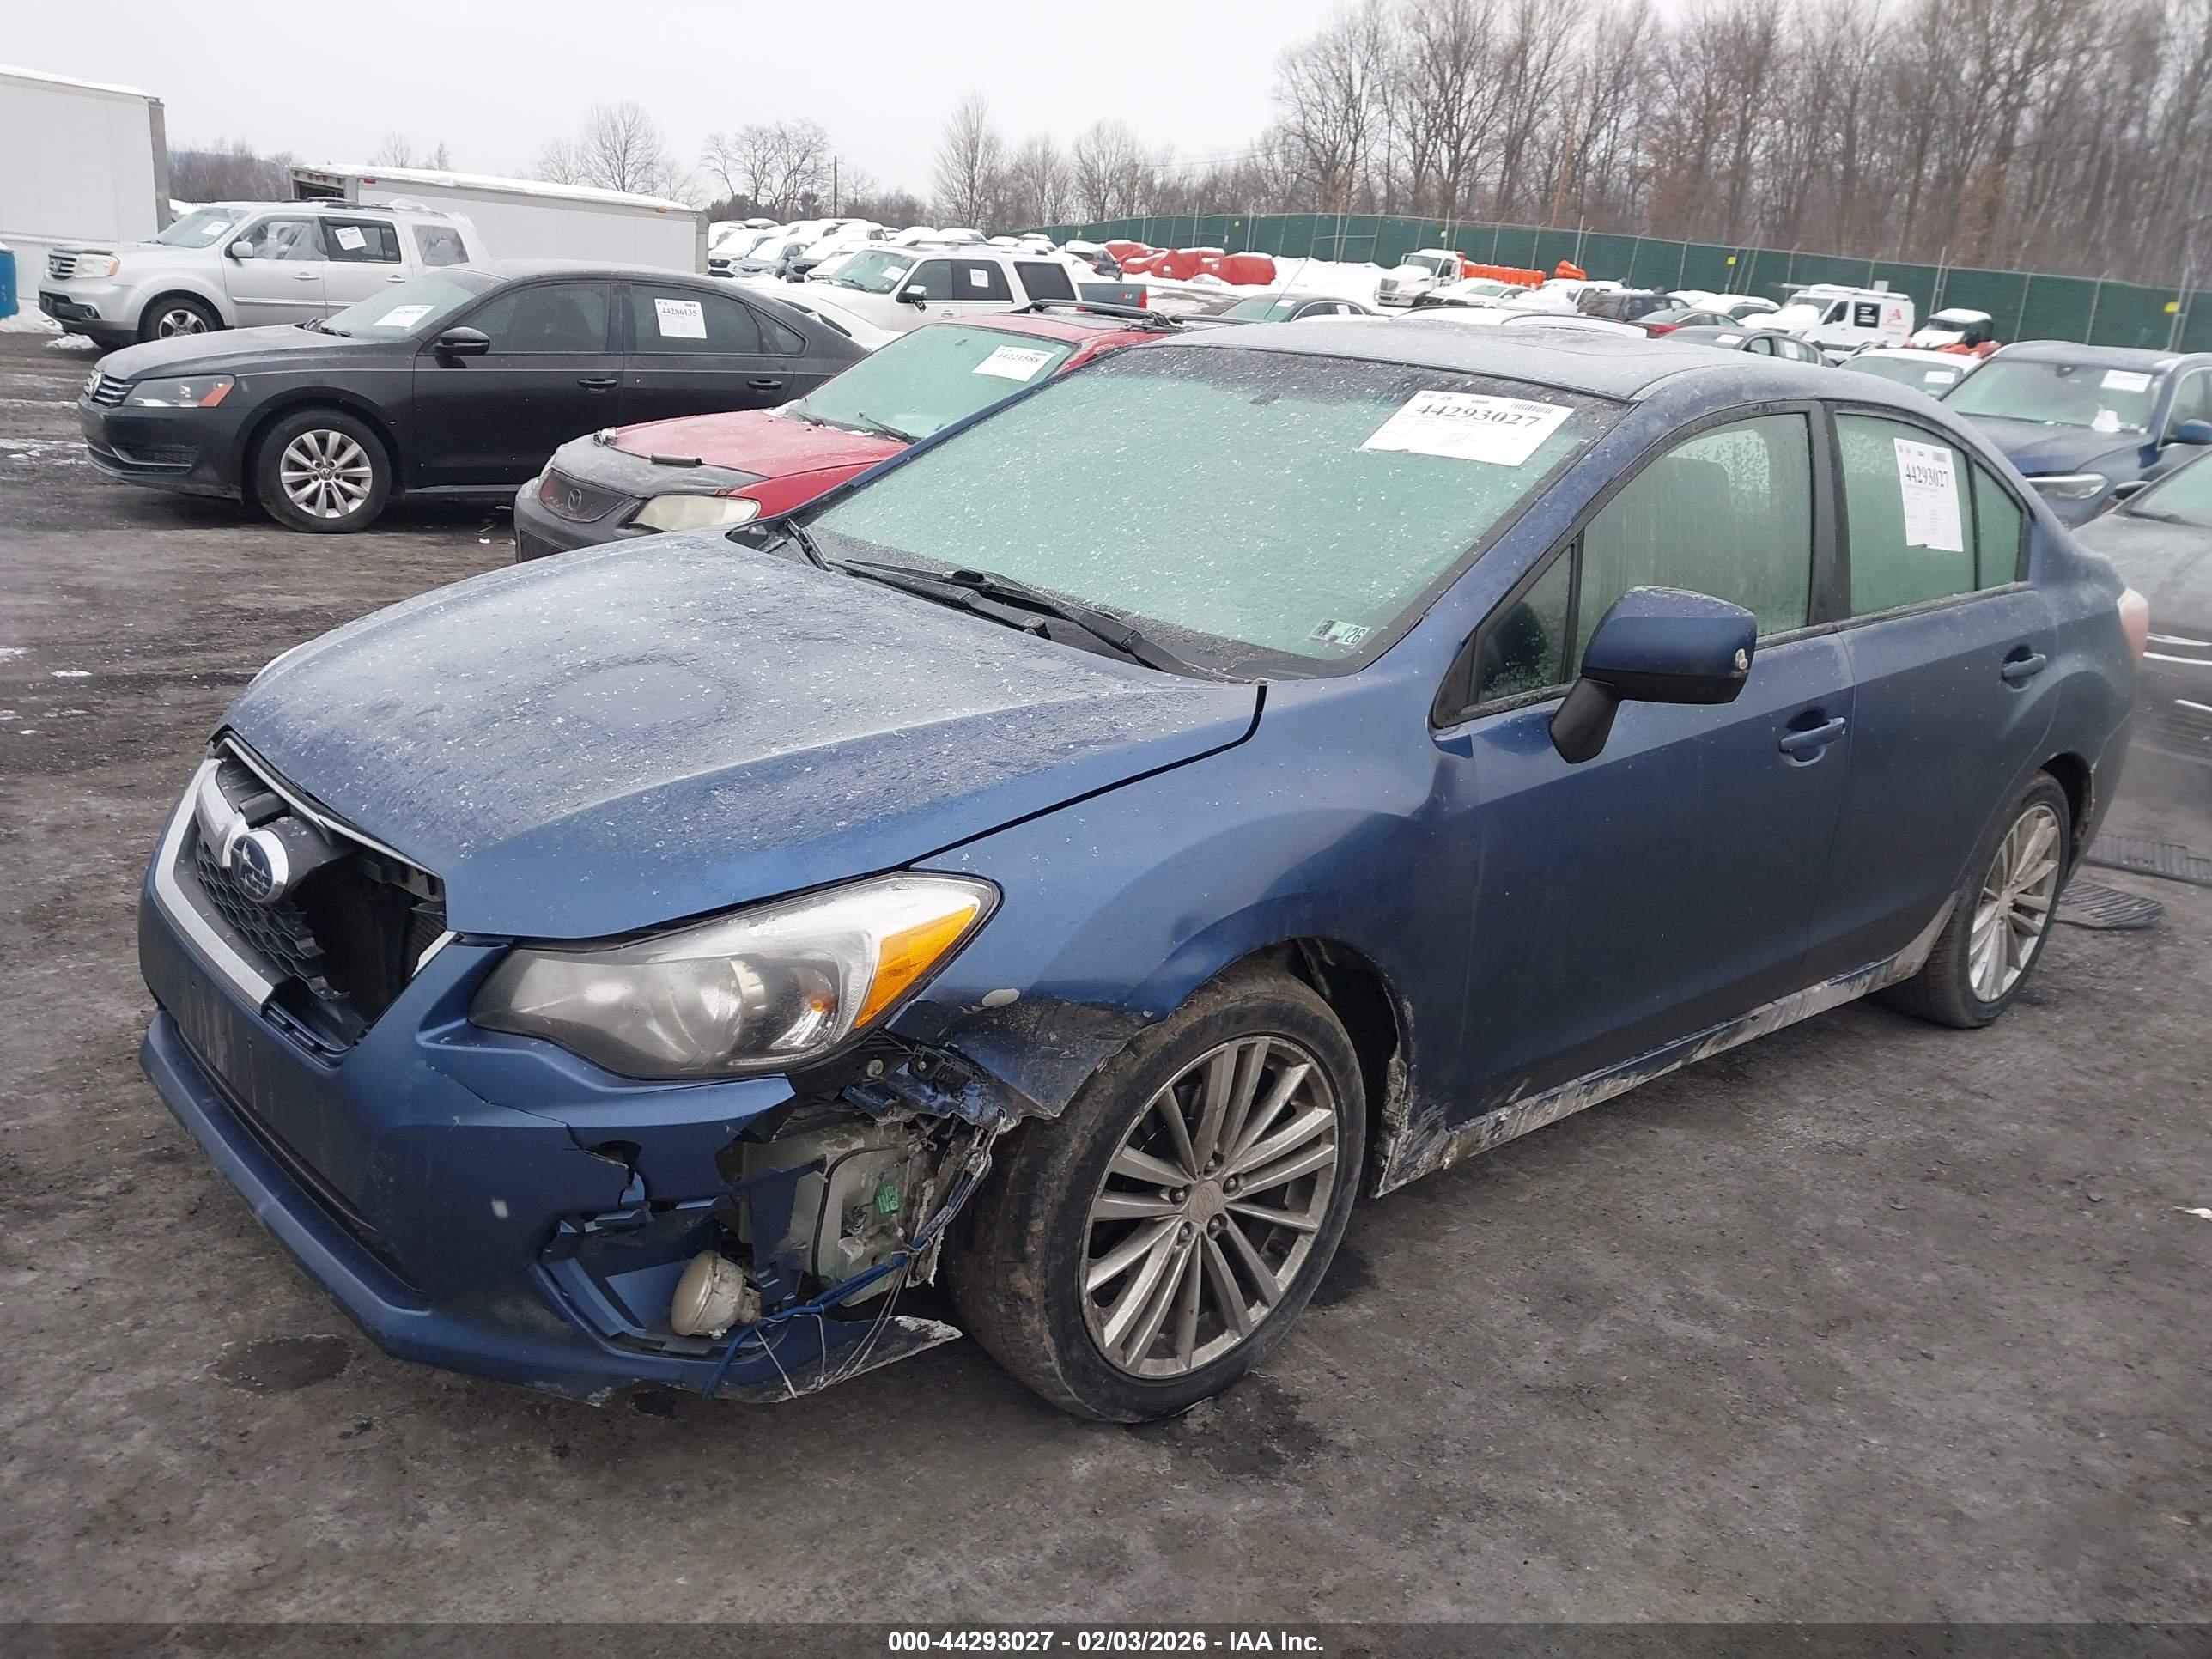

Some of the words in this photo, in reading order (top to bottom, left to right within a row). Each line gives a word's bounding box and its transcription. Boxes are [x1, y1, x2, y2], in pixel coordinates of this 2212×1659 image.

[1415, 404, 1542, 428] 44293027
[1905, 463, 1949, 489] 44293027
[1345, 627, 1366, 644] 26
